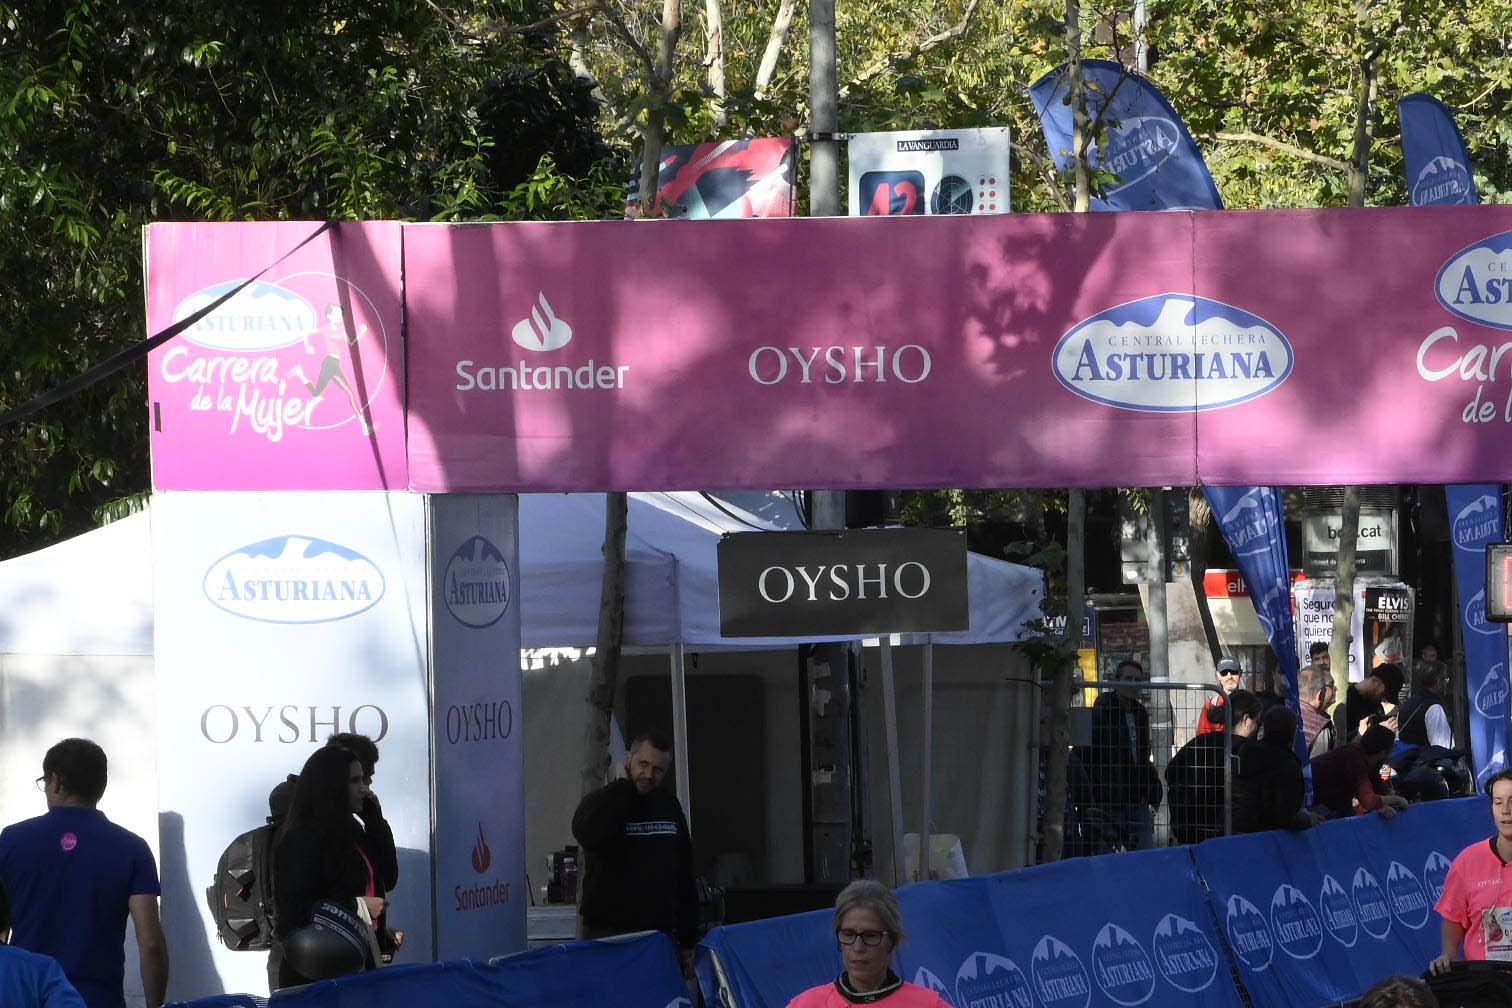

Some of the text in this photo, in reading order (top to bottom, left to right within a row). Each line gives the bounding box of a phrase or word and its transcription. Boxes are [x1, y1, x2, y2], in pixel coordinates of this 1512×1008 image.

[1107, 332, 1268, 347] CENTRAL LECHERA
[160, 345, 280, 384] Carrera
[455, 358, 630, 392] Santander
[747, 343, 933, 387] OYSHO
[1070, 337, 1275, 383] ASTURIANA
[191, 375, 325, 442] de la Mujer
[1461, 384, 1497, 425] de
[216, 569, 373, 603] ASTURIANA
[448, 570, 507, 606] ASTURIANA
[757, 560, 931, 604] OYSHO
[1303, 613, 1320, 624] que
[1377, 596, 1409, 610] ELVIS
[199, 703, 390, 746] OYSHO
[446, 699, 513, 745] OYSHO
[454, 876, 513, 914] Santander
